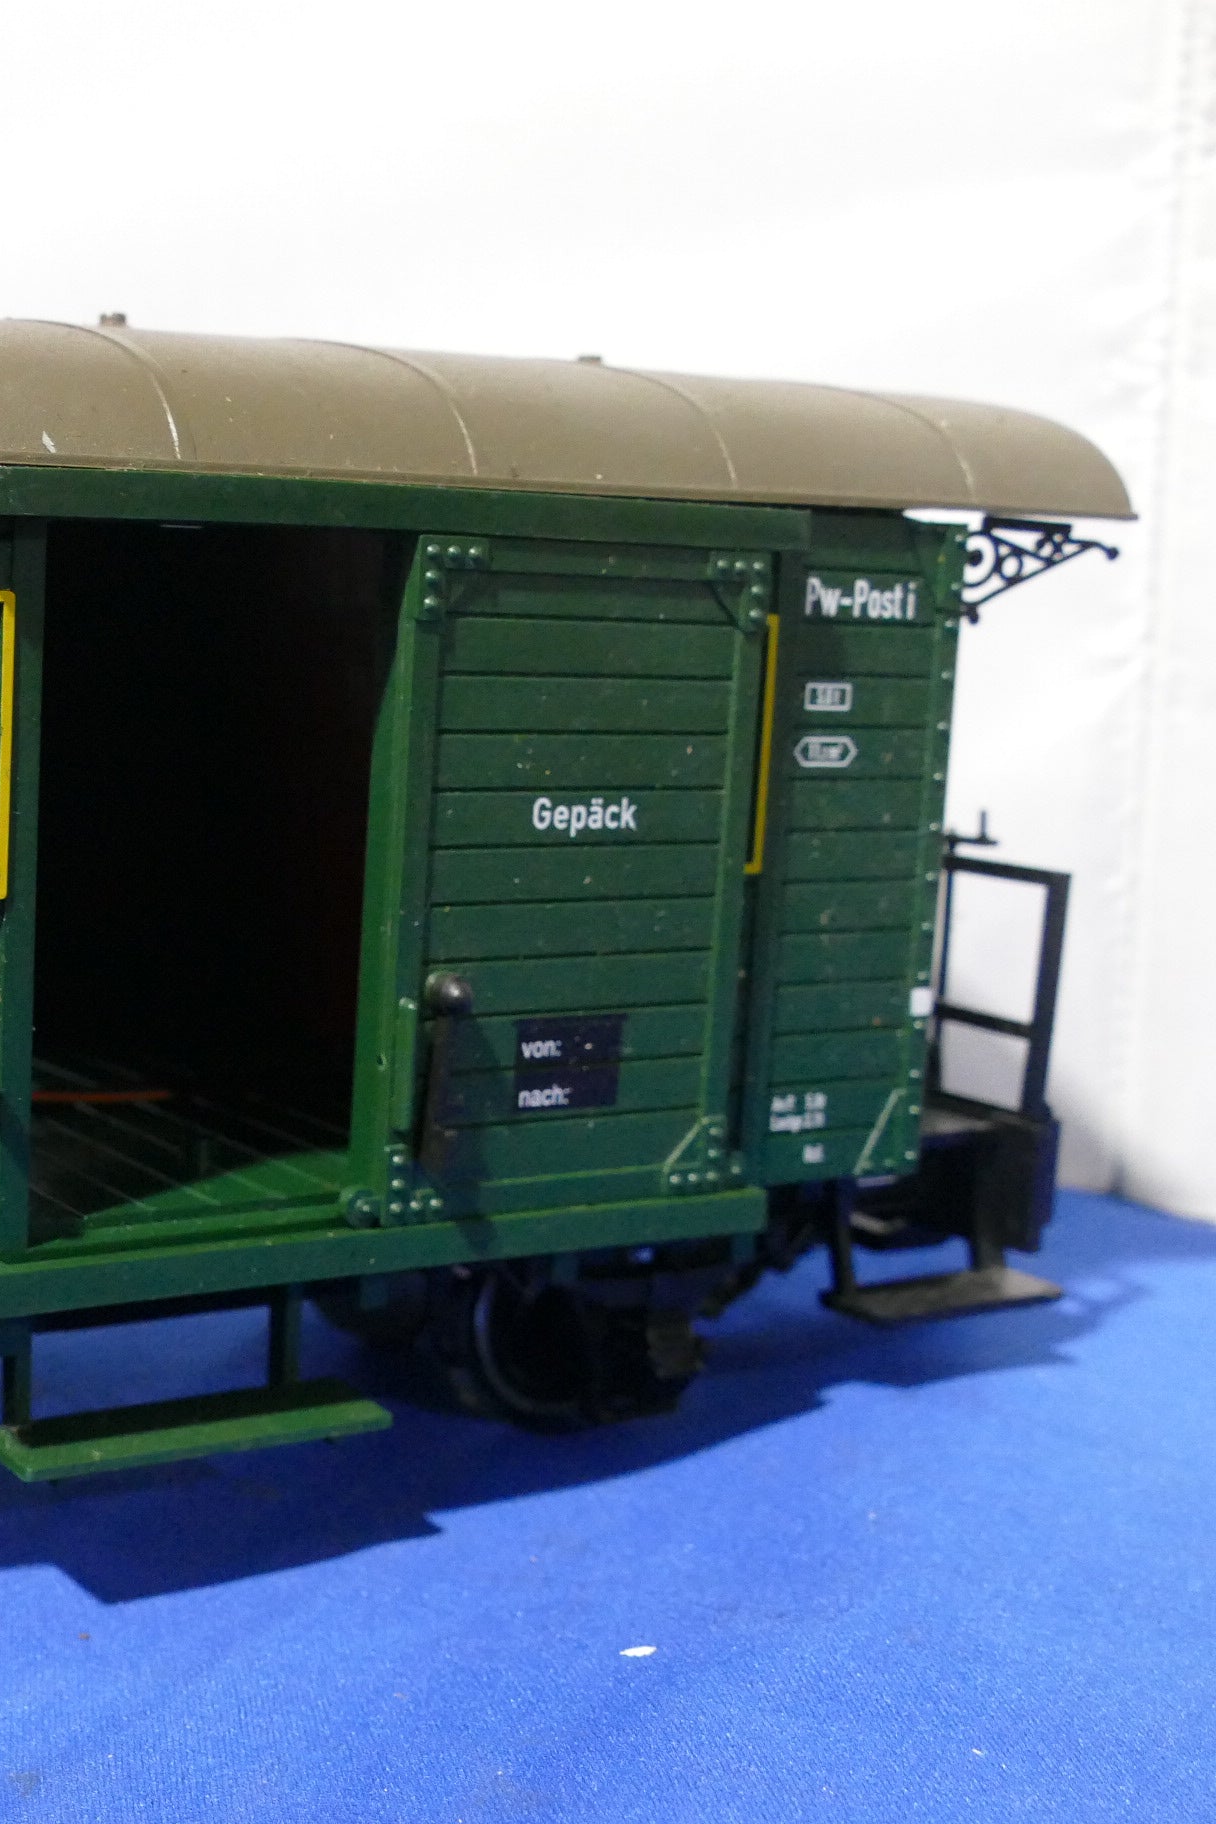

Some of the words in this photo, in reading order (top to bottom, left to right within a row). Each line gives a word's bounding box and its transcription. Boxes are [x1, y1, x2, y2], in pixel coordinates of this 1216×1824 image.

[532, 796, 638, 838] Gepäck
[521, 1039, 563, 1060] von:
[518, 1083, 574, 1108] nach:
